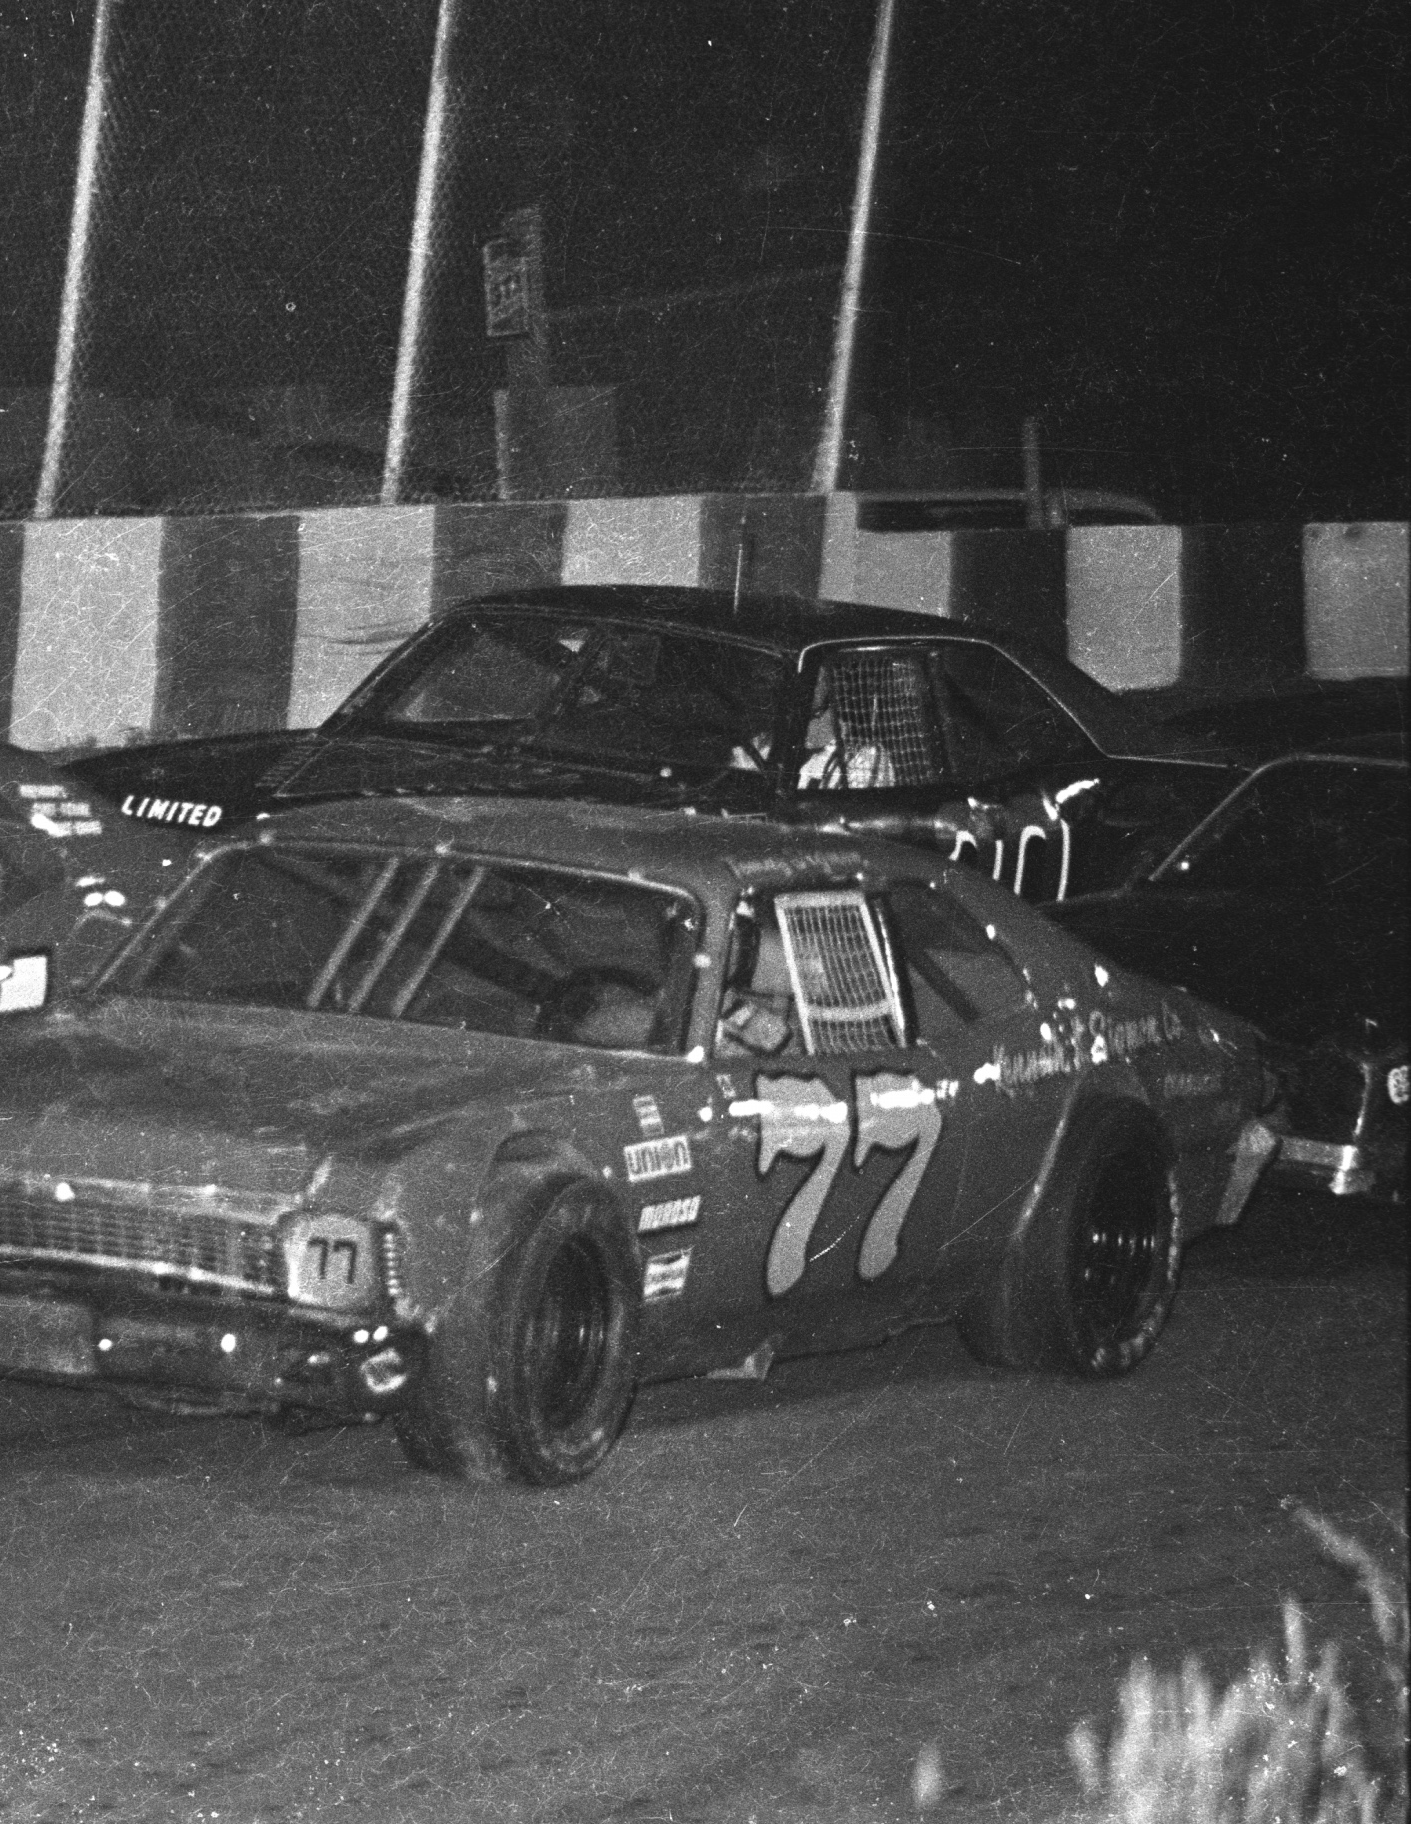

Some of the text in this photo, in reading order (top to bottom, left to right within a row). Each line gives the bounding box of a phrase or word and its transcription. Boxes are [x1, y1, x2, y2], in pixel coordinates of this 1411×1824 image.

[121, 795, 222, 827] LIMITED
[756, 1072, 942, 1295] 77
[307, 1237, 357, 1285] 77
